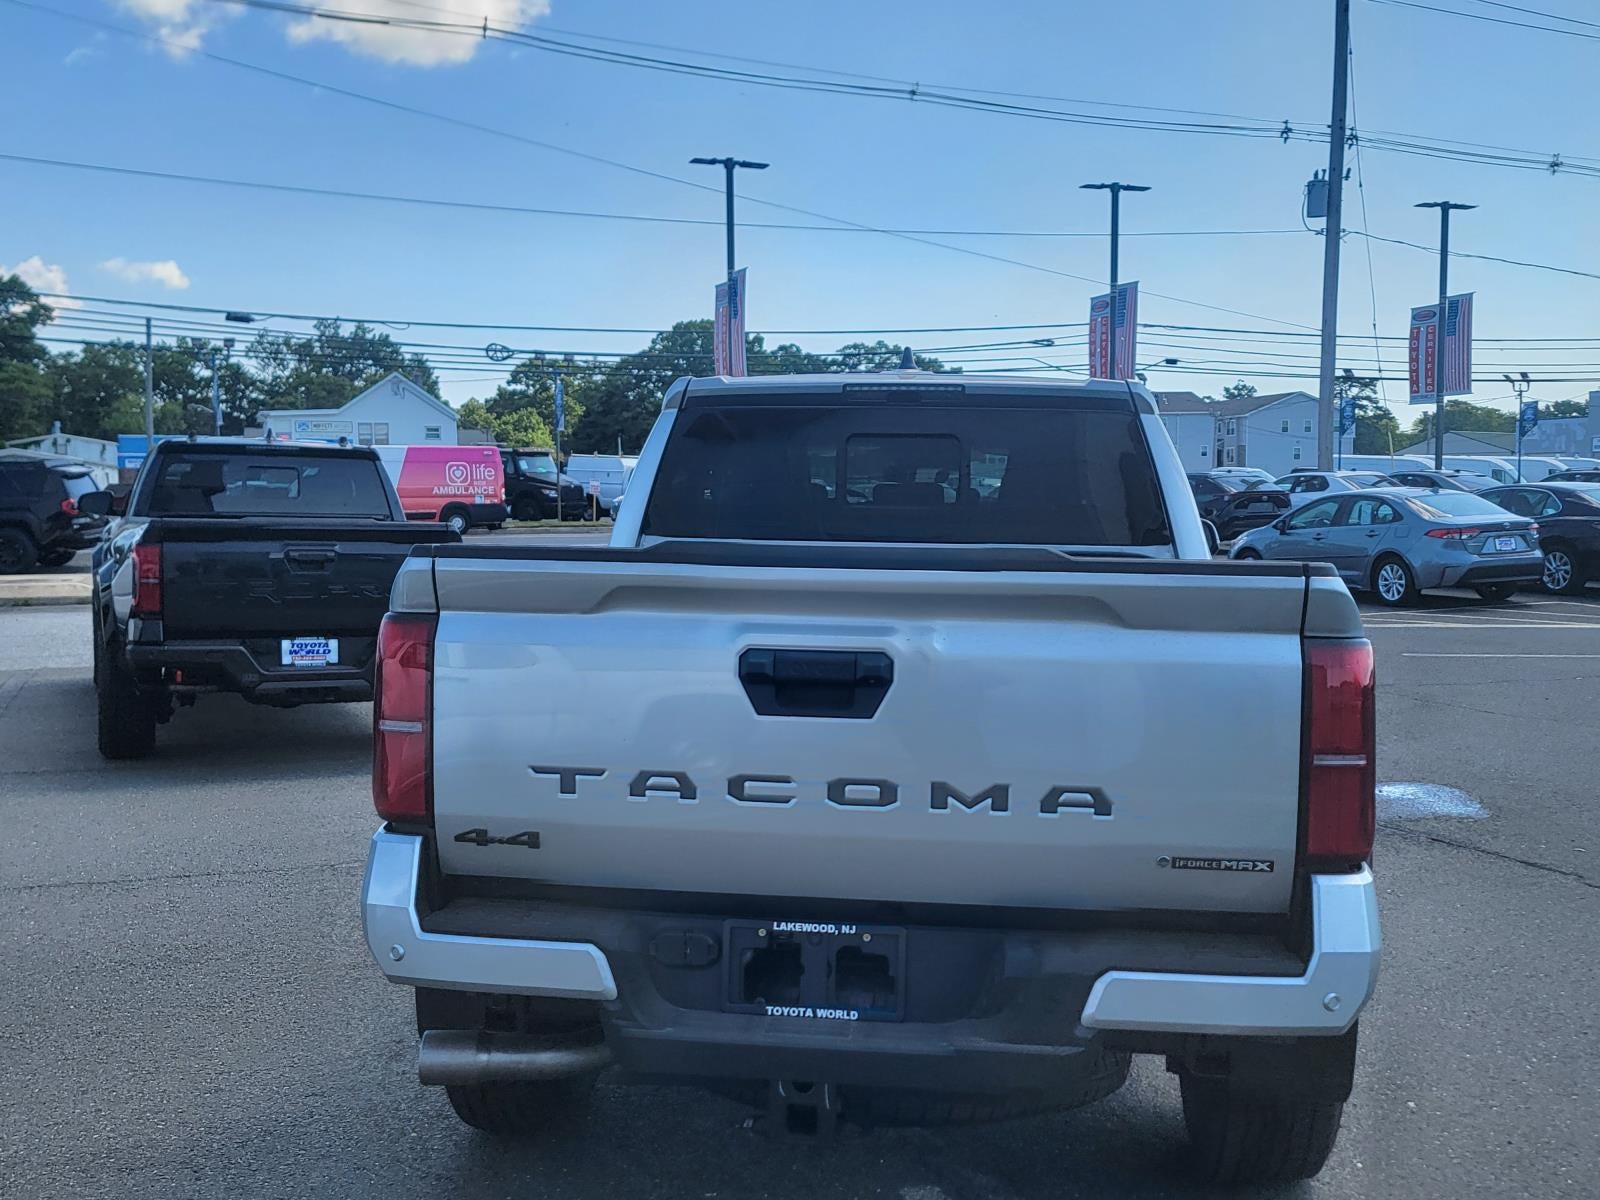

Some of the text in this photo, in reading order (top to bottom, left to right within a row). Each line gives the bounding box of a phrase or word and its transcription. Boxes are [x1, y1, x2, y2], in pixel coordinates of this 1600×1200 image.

[1410, 329, 1419, 392] TOYOTA
[1426, 326, 1435, 391] CERTIFIED
[472, 463, 495, 480] life
[432, 486, 495, 495] AMBULANCE
[528, 764, 1114, 821] TACOMA
[772, 921, 857, 936] LAKEWOOD, NJ
[765, 1005, 859, 1021] TOYOTA WORLD
